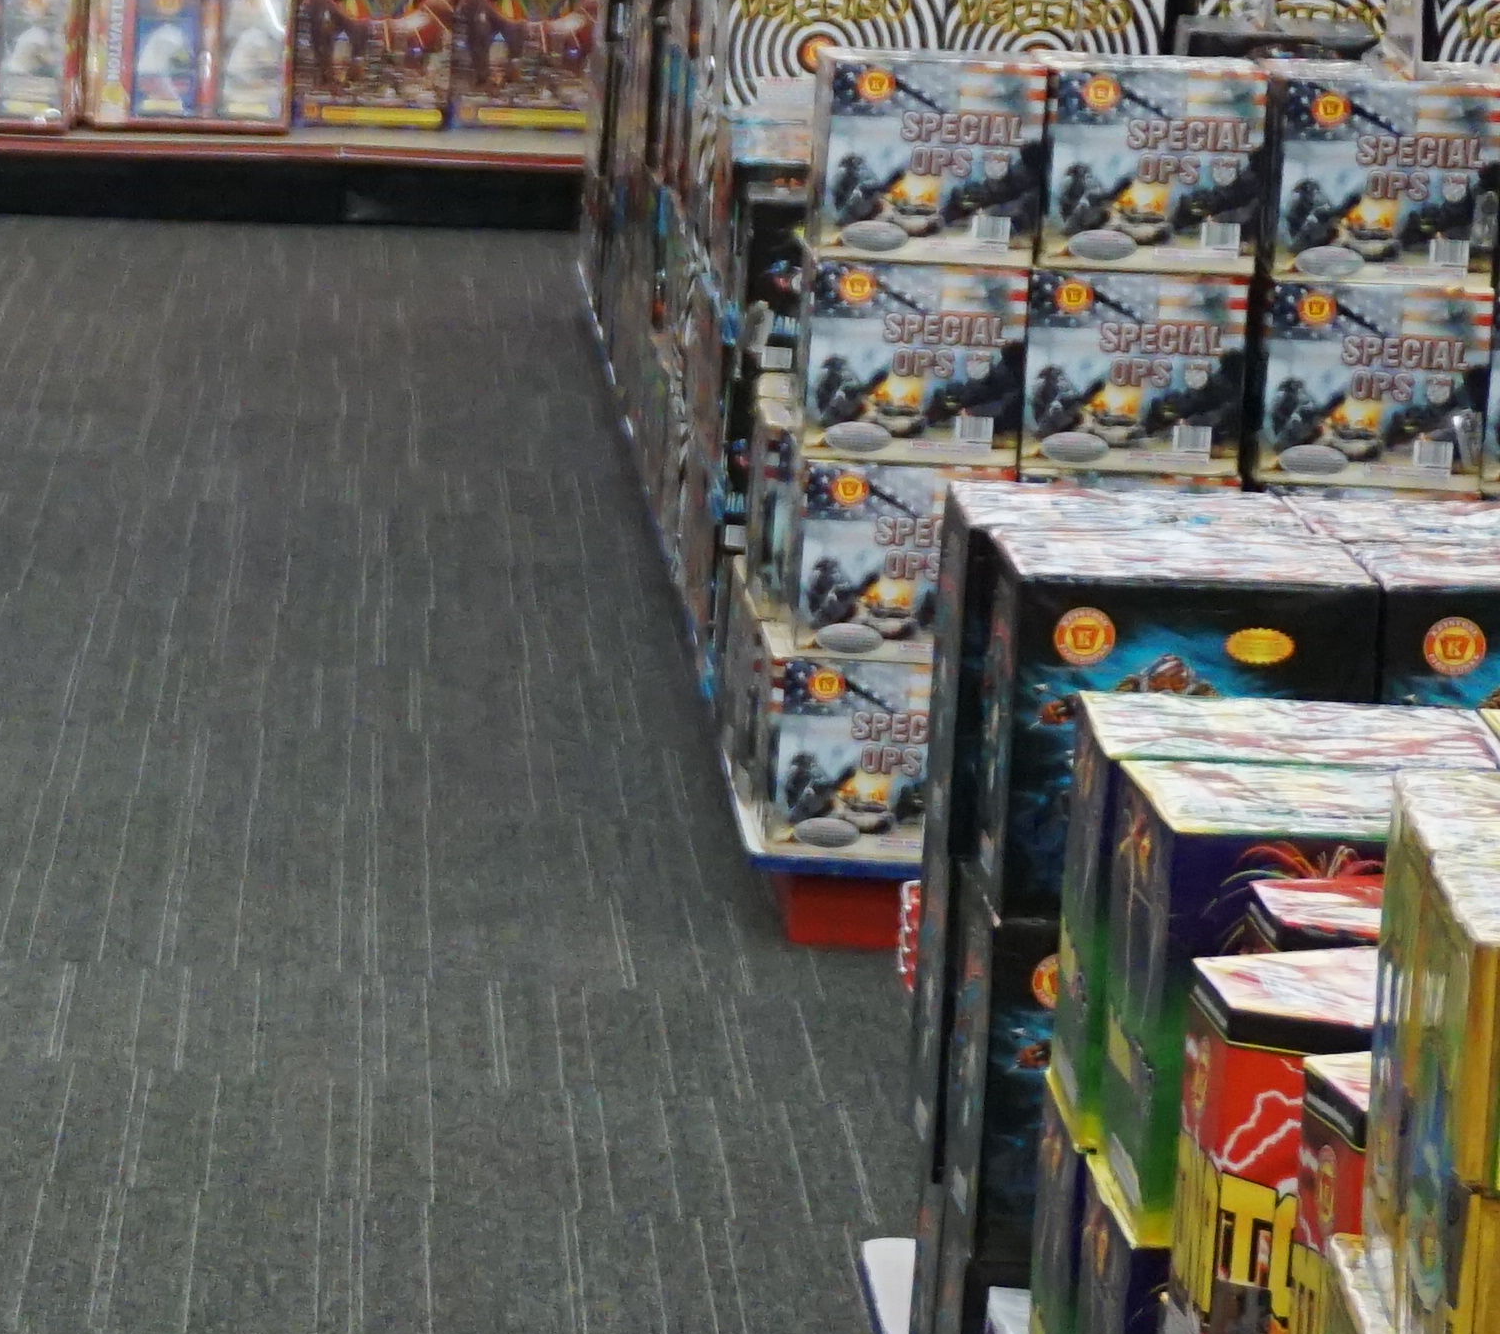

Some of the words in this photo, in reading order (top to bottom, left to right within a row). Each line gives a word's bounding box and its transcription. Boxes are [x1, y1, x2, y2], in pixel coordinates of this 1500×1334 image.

[901, 111, 1023, 147] SPECIAL
[1127, 119, 1251, 152] SPECIAL
[910, 146, 974, 176] OPS
[1356, 135, 1482, 168] SPECIAL
[1137, 153, 1200, 185] OPS
[1365, 169, 1429, 201] OPS
[884, 313, 1006, 348] SPECIAL
[1099, 321, 1224, 356] SPECIAL
[892, 347, 955, 378] OPS
[1342, 335, 1468, 369] SPECIAL
[1109, 357, 1172, 388] OPS
[1350, 370, 1412, 401] OPS
[874, 516, 942, 547] SPEC
[851, 711, 927, 742] SPEC
